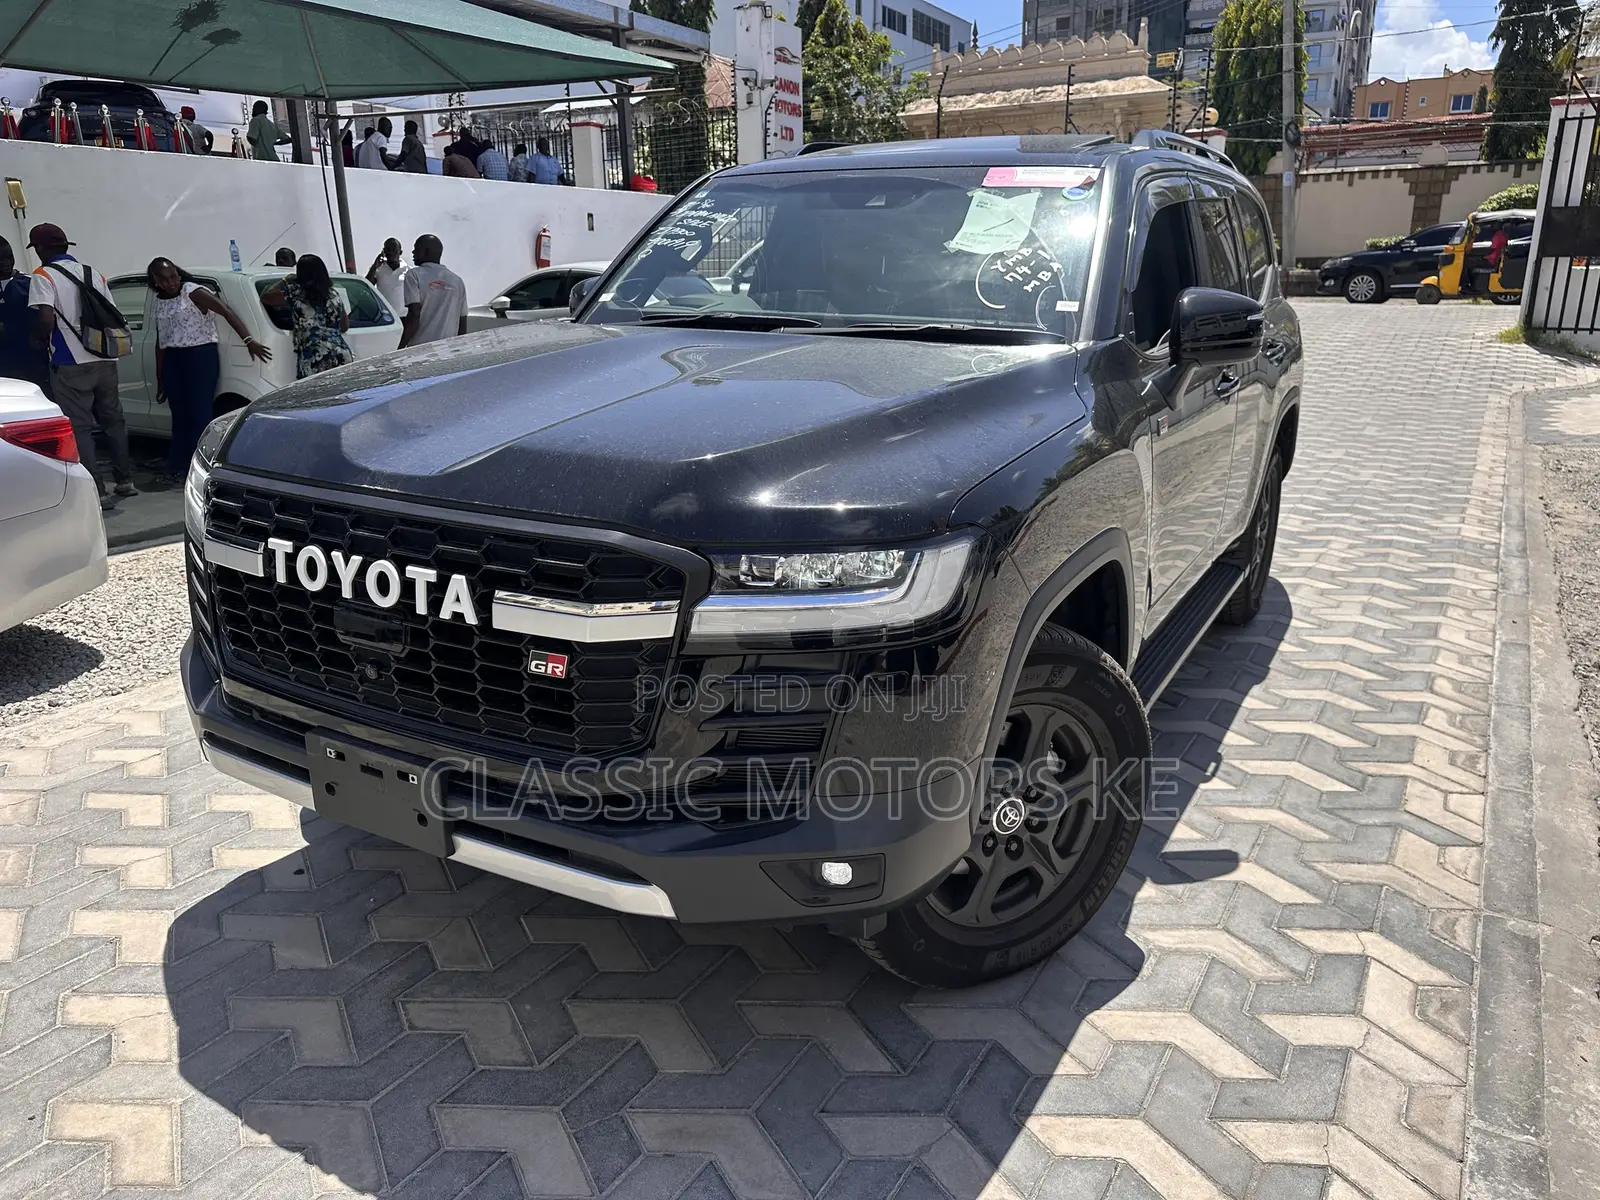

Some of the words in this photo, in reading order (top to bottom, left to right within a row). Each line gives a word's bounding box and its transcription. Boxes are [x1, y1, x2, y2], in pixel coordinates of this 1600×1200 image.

[780, 125, 794, 141] LTD
[268, 537, 479, 625] TOYOTA
[530, 660, 564, 676] GR
